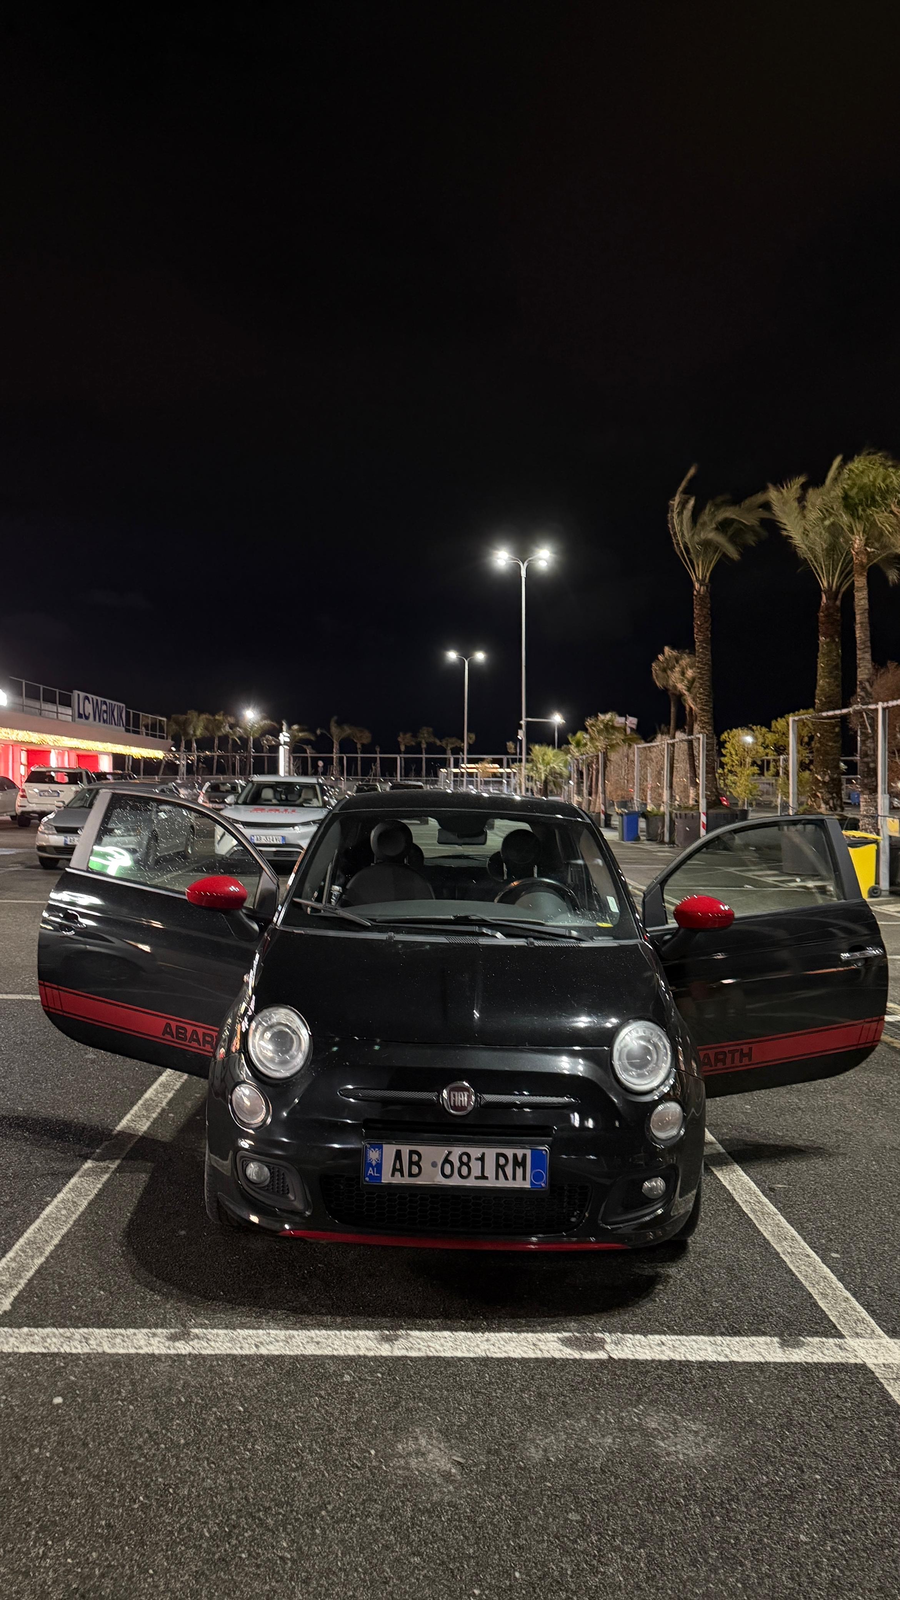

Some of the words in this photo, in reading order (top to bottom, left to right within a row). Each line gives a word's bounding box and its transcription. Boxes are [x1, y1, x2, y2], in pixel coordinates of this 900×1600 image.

[161, 1021, 217, 1050] ABAR
[450, 1091, 470, 1107] FIAT
[367, 1166, 380, 1177] AL
[390, 1148, 423, 1179] AB
